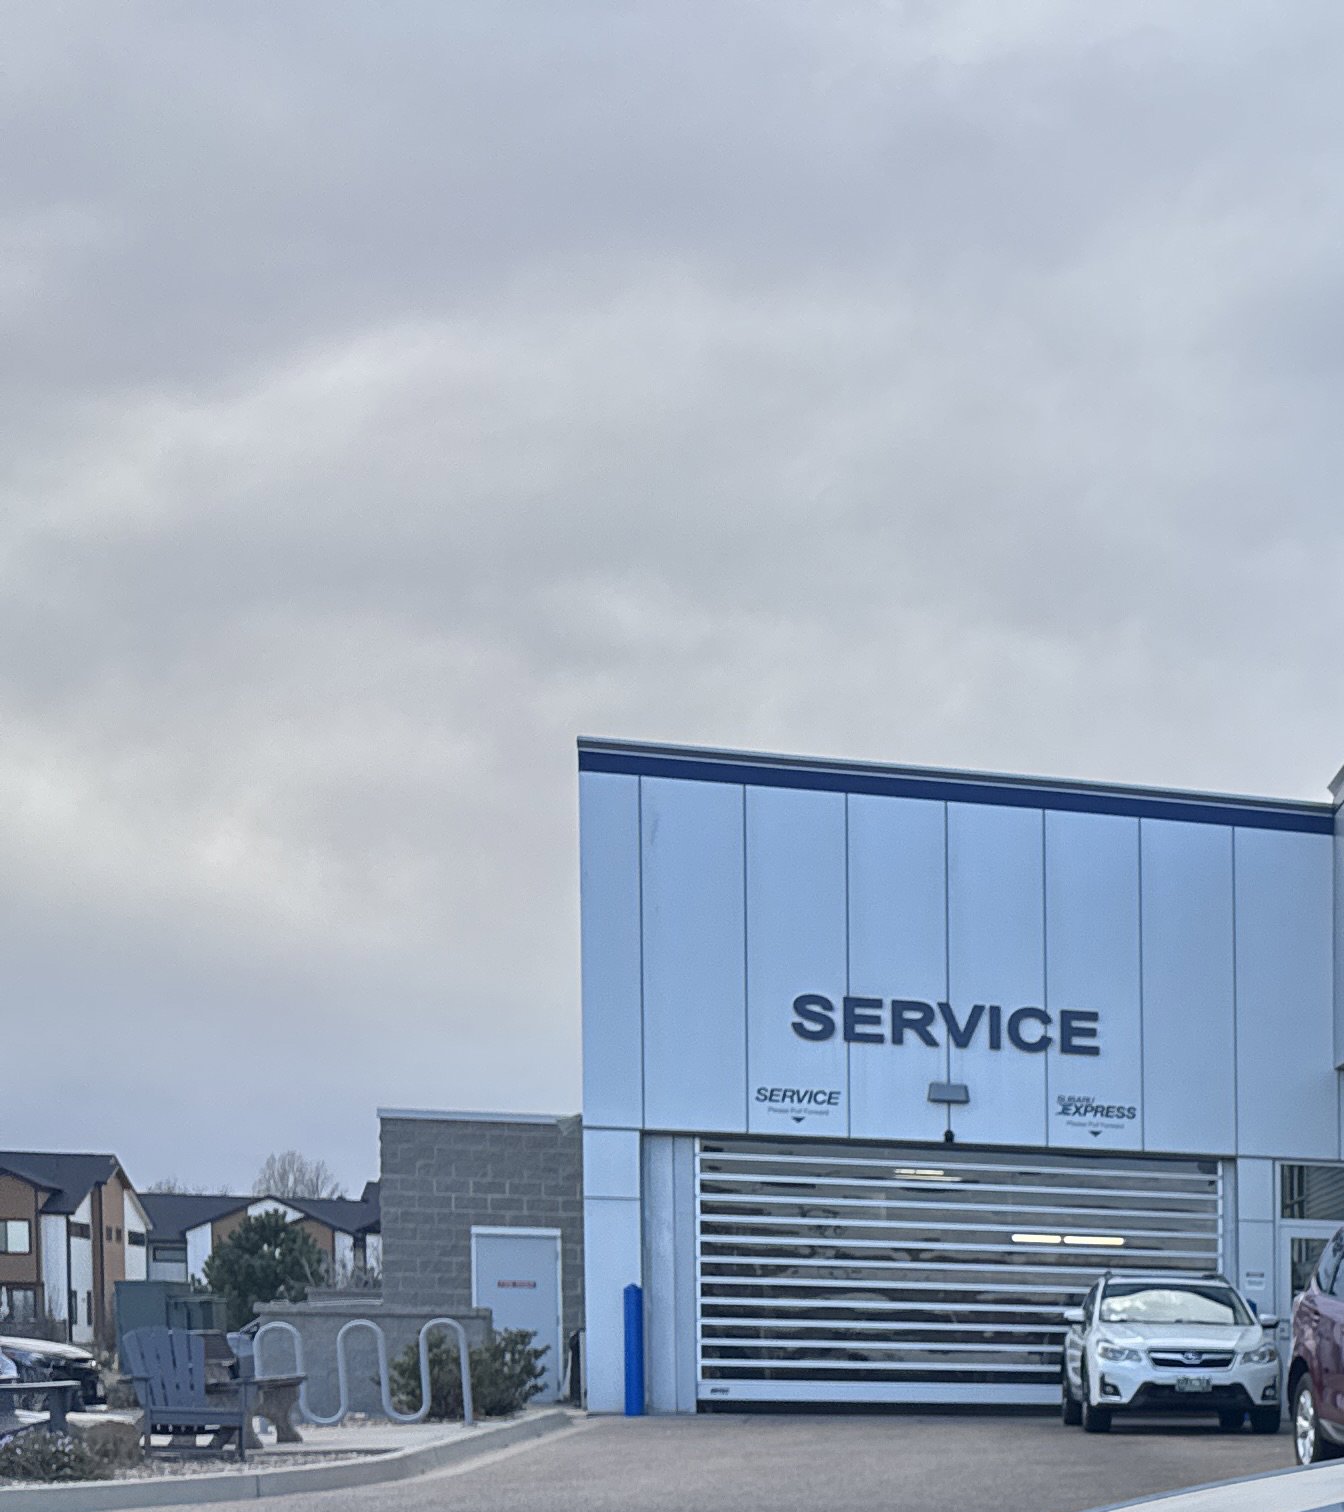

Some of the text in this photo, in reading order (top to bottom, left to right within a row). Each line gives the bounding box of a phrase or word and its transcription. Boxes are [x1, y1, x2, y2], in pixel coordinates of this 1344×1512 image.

[791, 993, 1101, 1057] SERVICE
[755, 1086, 842, 1106] SERVICE
[1058, 1104, 1137, 1120] EXPRESS
